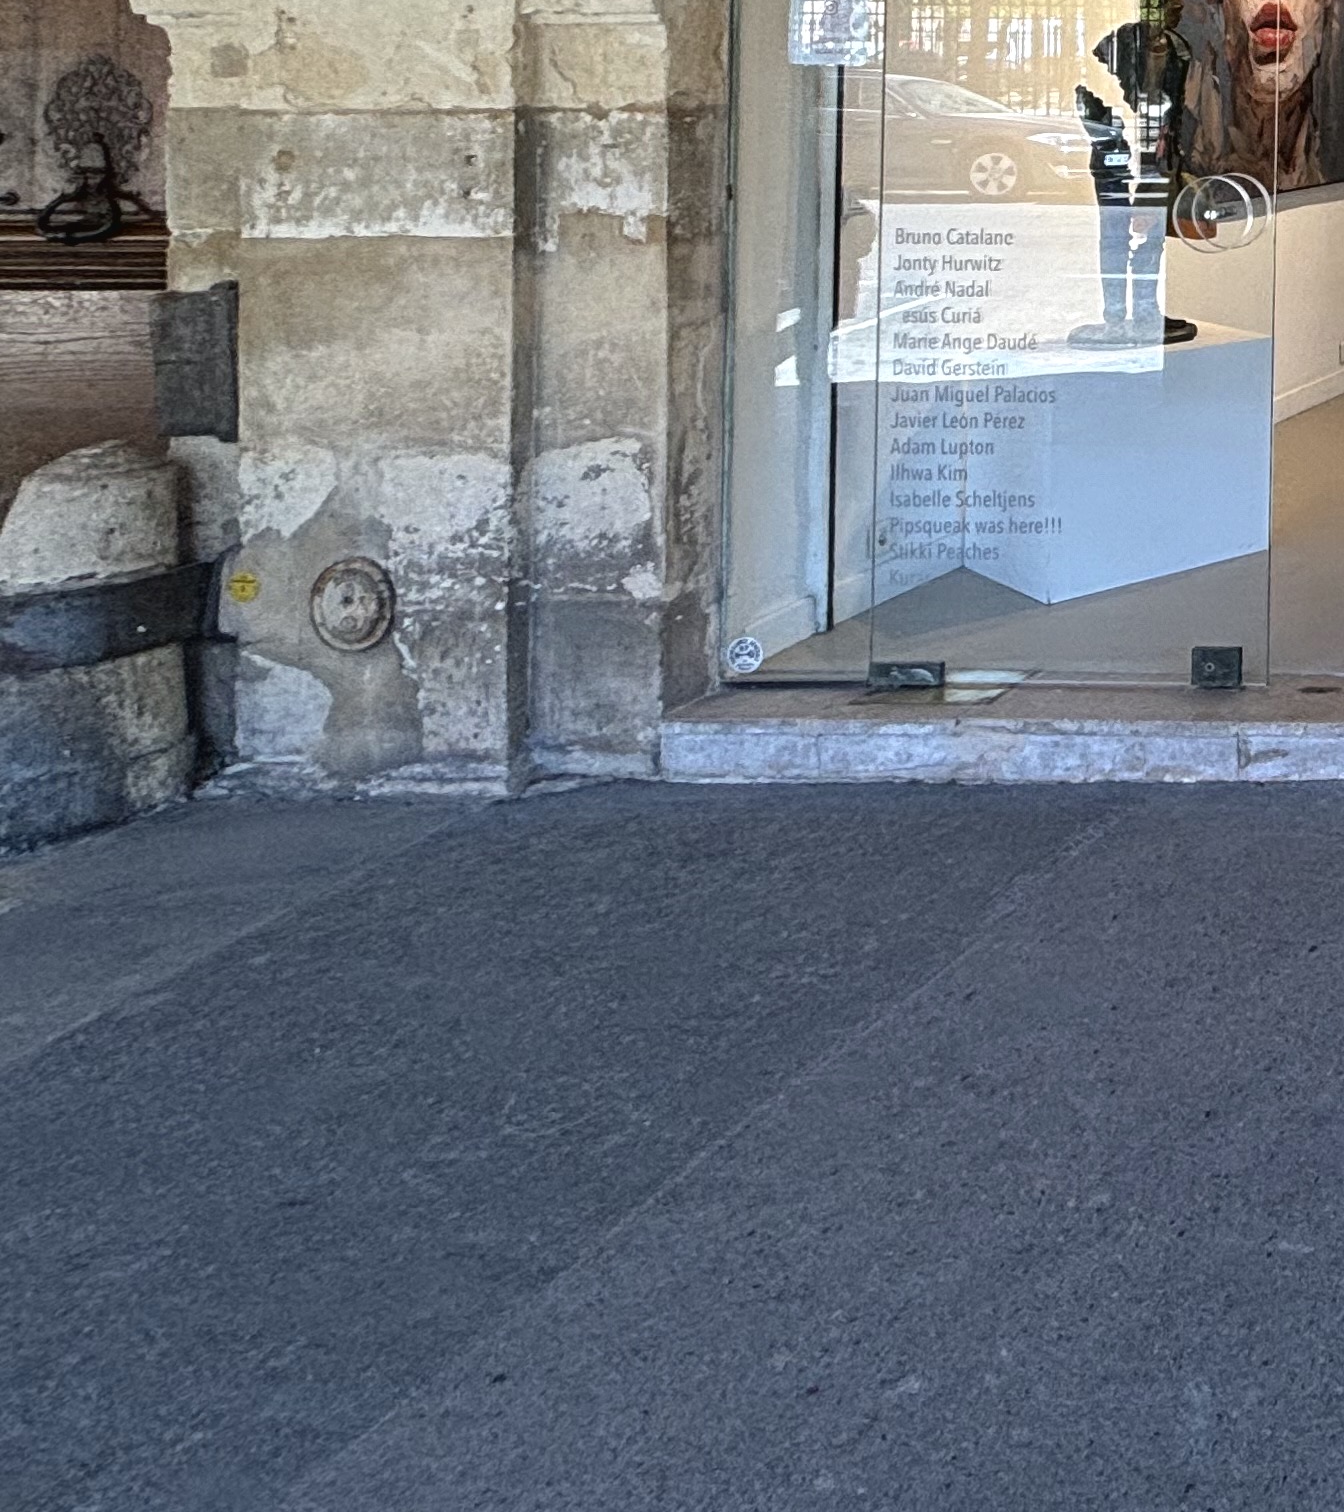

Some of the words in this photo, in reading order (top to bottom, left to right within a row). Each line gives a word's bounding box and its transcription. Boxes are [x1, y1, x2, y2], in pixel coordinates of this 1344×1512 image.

[895, 228, 941, 245] Bruno
[946, 228, 1014, 246] Catalano
[893, 254, 937, 276] Jonty
[942, 255, 1003, 272] Hurwitz
[894, 280, 940, 297] André
[945, 280, 990, 298] Nadal
[901, 306, 937, 324] esús
[893, 333, 939, 350] Marie
[941, 333, 983, 355] Ange
[987, 333, 1038, 350] Daudé
[893, 359, 936, 376] David
[941, 359, 1006, 376] Gerstein
[891, 385, 929, 403] Juan
[935, 385, 989, 407] Miguel
[994, 385, 1057, 404] Palacios
[890, 411, 938, 429] Javier
[942, 412, 979, 429] León
[890, 438, 936, 455] Adam
[941, 438, 995, 459] Lupton
[890, 464, 933, 481] Ilhwa
[938, 464, 968, 481] Kim
[890, 490, 951, 508] Isabelle
[956, 490, 1036, 513] Scheltjens
[889, 517, 971, 537] Pipsqueak
[975, 520, 1004, 534] was
[1009, 517, 1062, 534] here!!!
[937, 542, 1000, 561] Peaches
